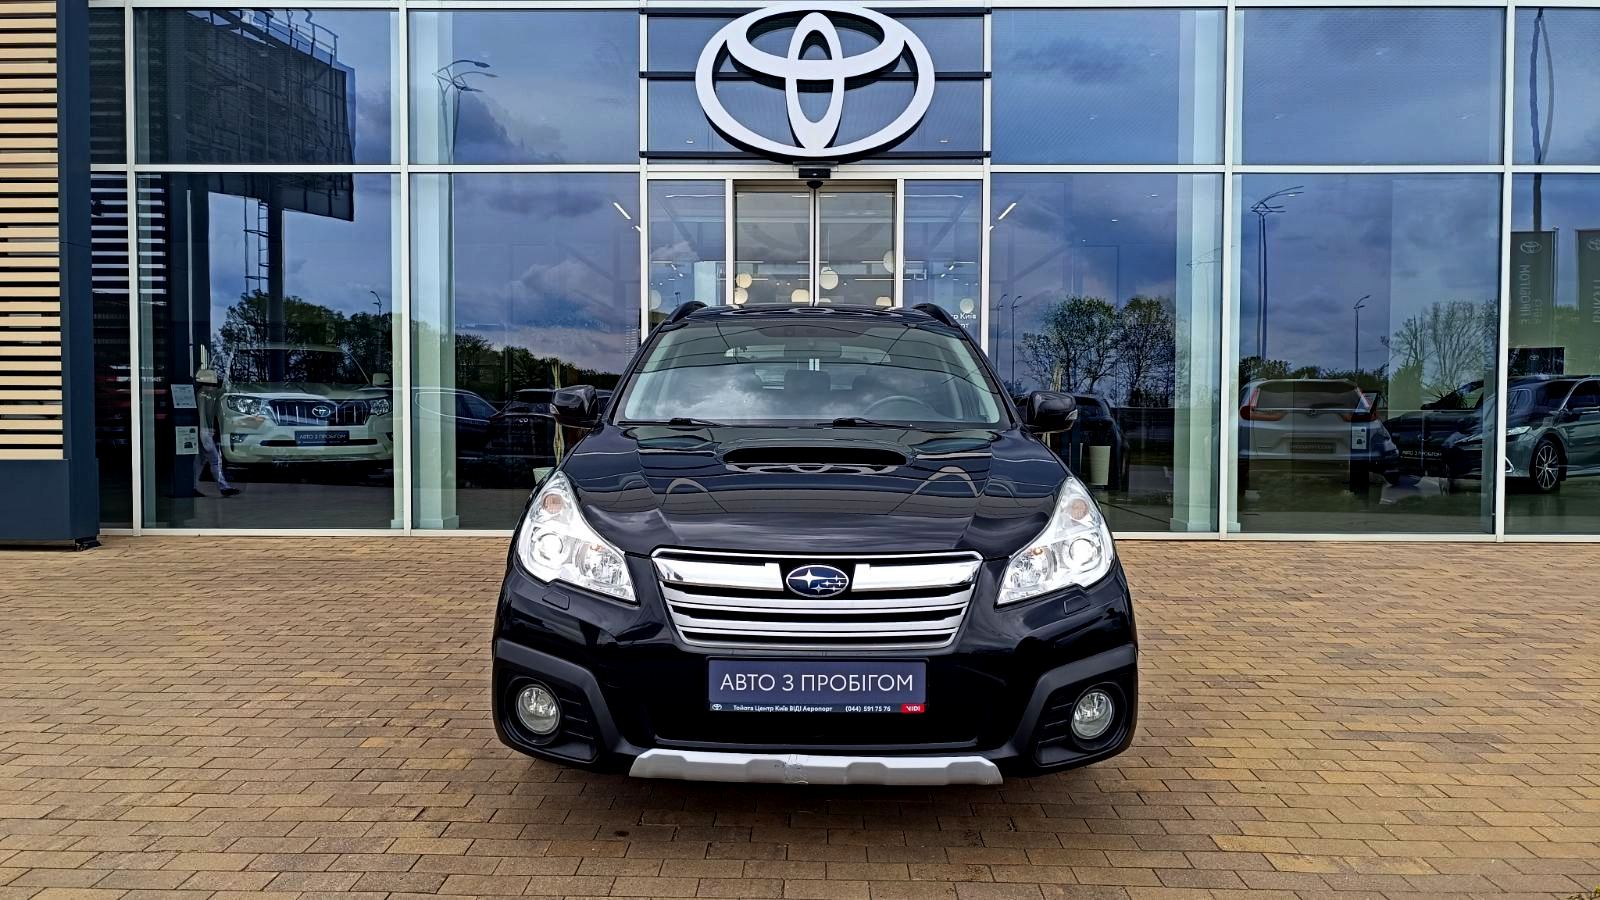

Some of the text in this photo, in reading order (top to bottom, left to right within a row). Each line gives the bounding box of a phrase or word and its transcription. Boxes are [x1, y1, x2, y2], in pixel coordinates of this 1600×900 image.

[720, 673, 913, 692] АВТО З ПРОБІГОМ
